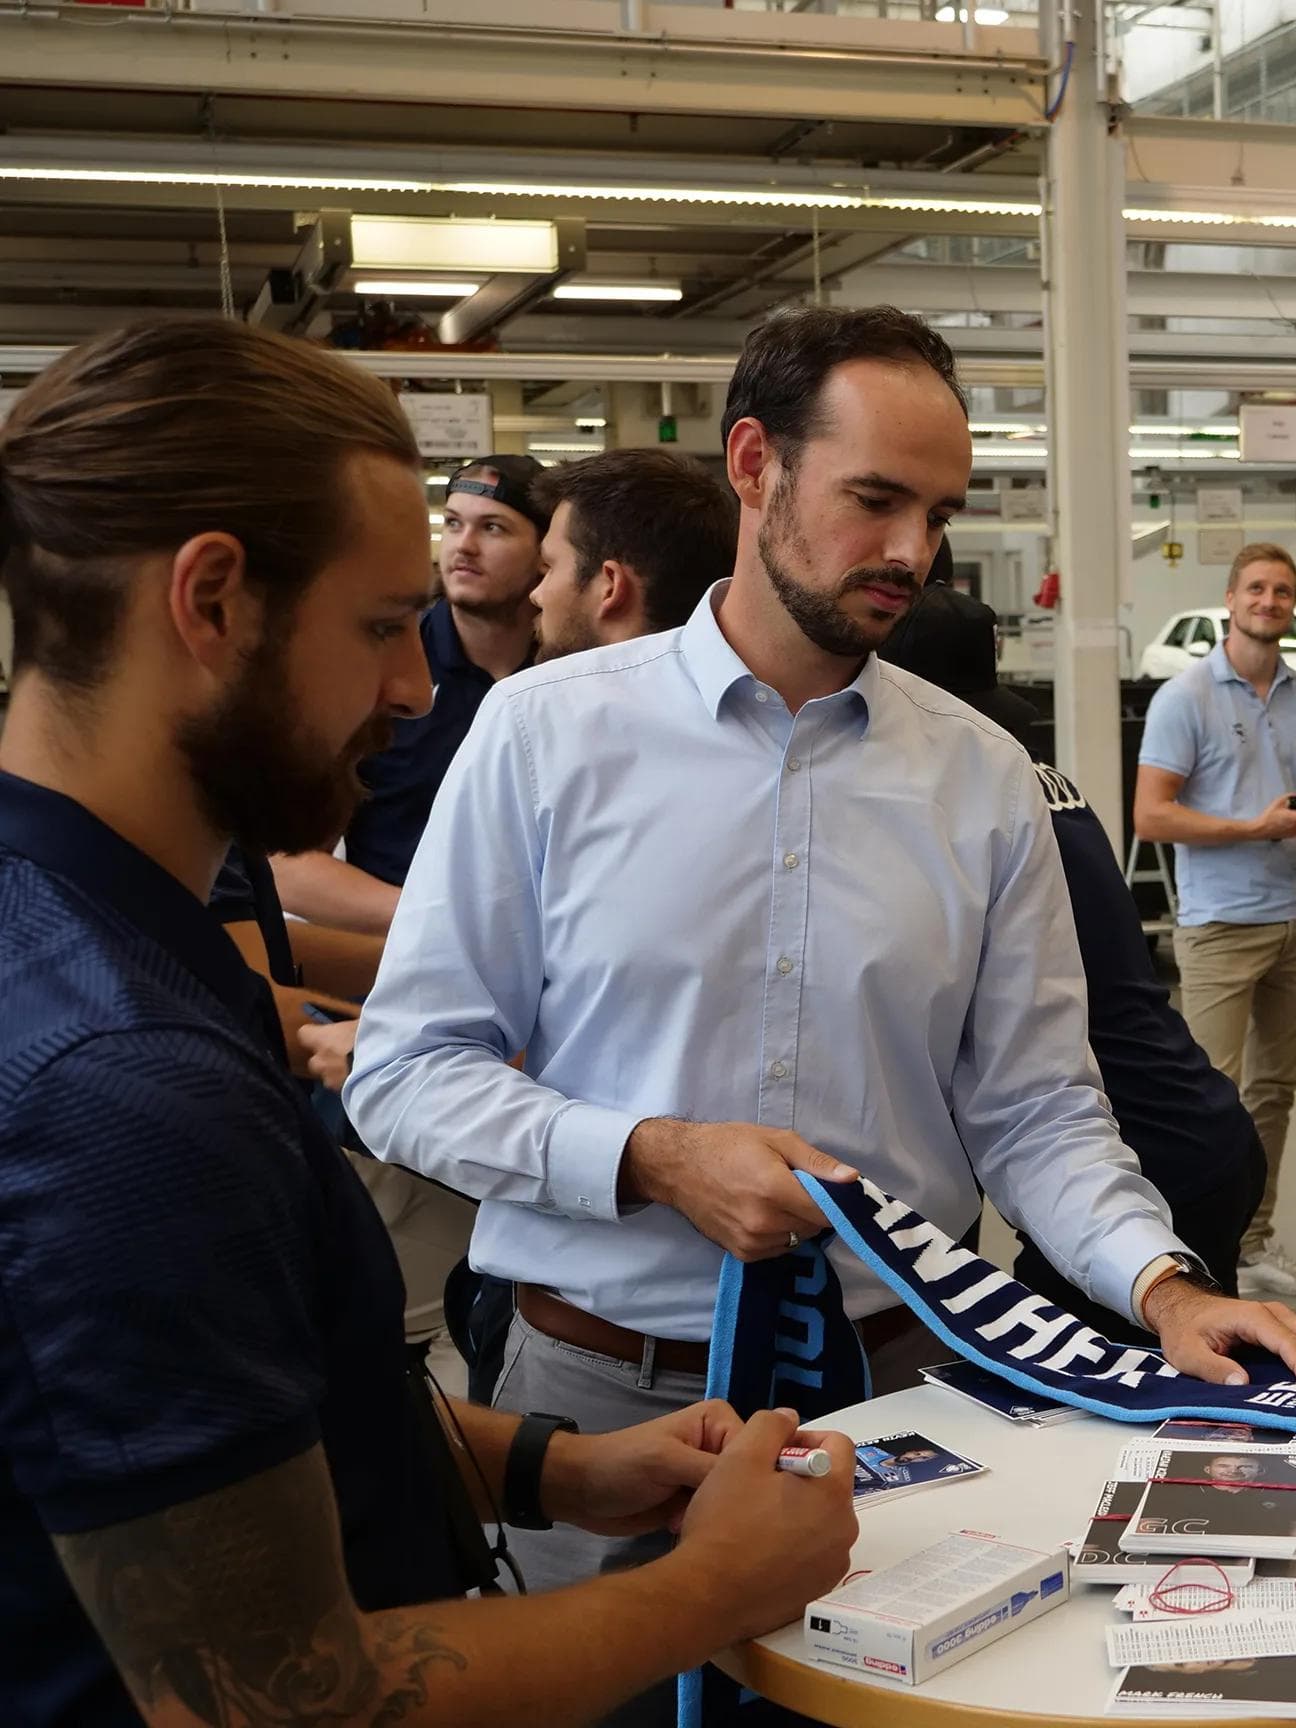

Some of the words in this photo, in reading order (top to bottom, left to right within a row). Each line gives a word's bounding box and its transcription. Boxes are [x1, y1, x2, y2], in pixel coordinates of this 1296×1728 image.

[1137, 1518, 1209, 1535] GC
[1080, 1551, 1150, 1566] DC
[963, 1613, 998, 1638] edding
[864, 1656, 899, 1674] edding
[1118, 1690, 1163, 1698] MARK
[1166, 1691, 1224, 1700] FRENCH
